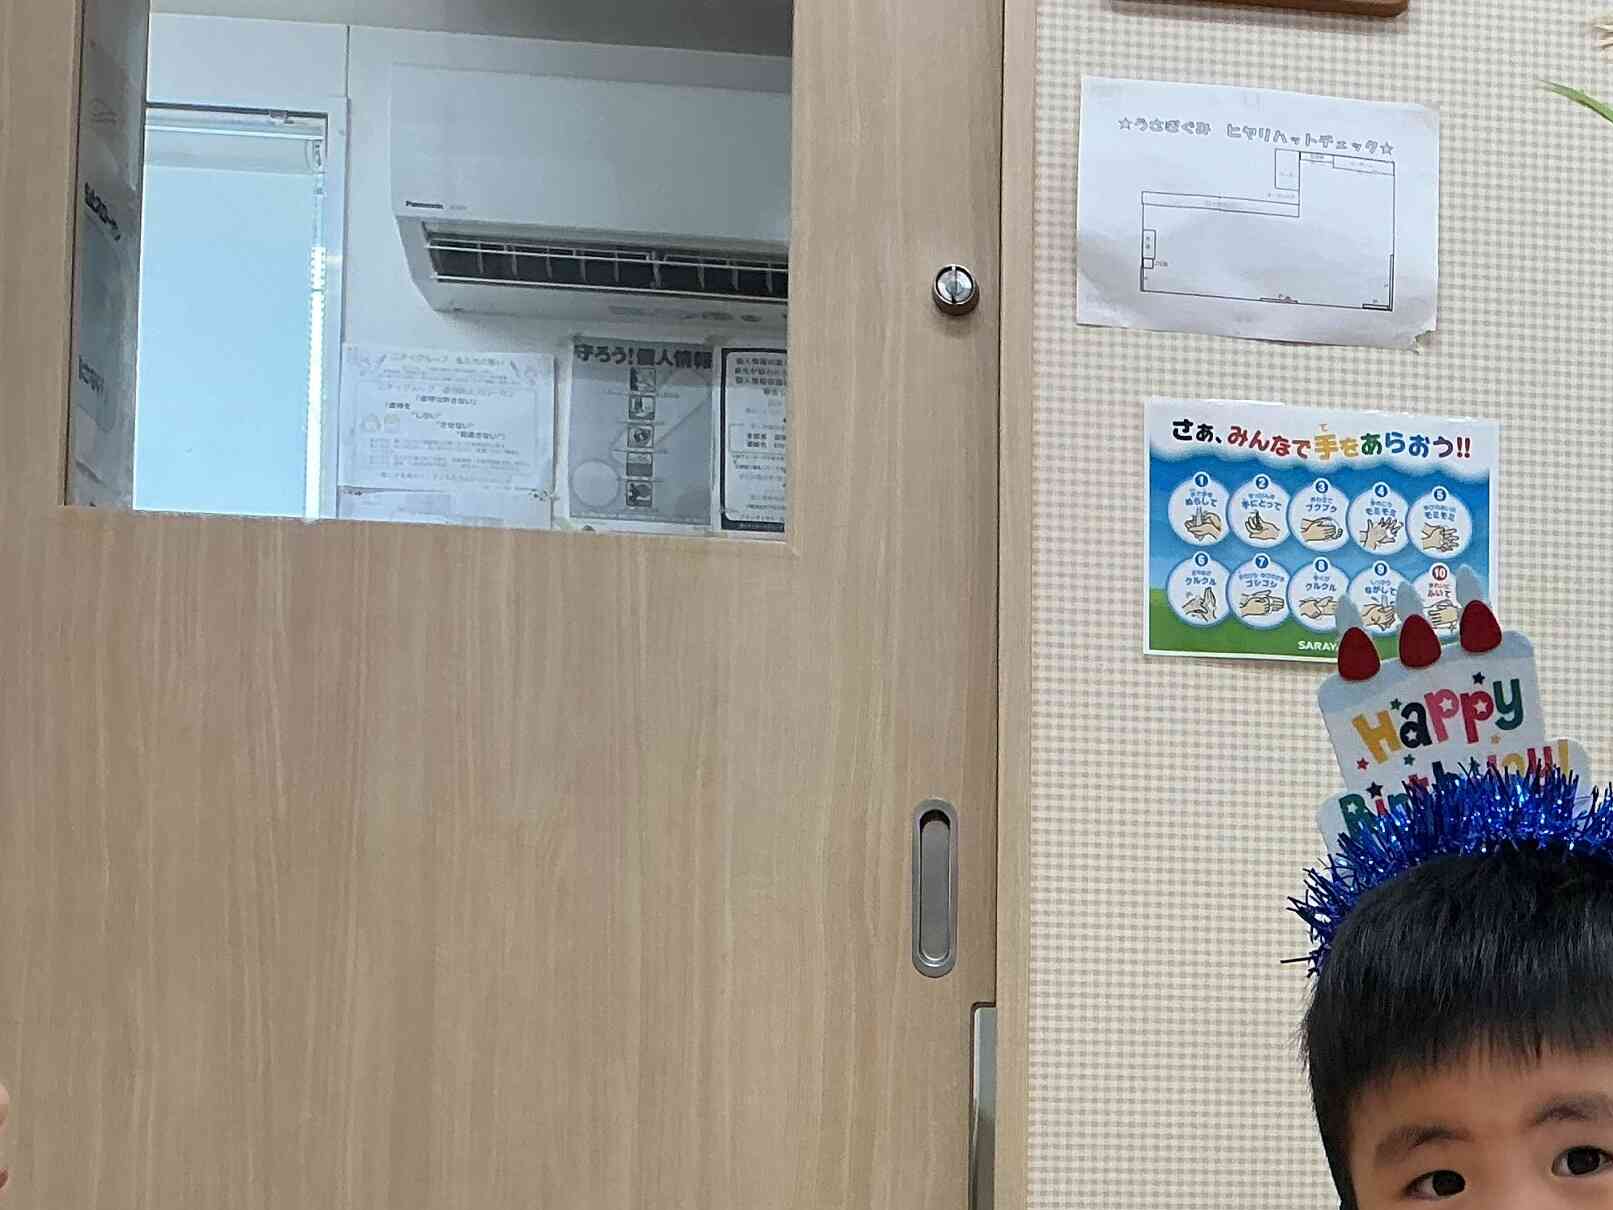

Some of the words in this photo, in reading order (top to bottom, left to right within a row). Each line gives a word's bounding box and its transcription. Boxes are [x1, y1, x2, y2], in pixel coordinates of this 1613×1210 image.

[1226, 123, 1379, 154] ヒヤリハットチェック
[1172, 418, 1472, 459] さあ、みんなで手をあらおう!!
[1241, 498, 1282, 511] 手にとって
[1365, 507, 1397, 517] モミモミ
[1425, 512, 1456, 522] モミモミ
[1297, 640, 1338, 651] SARAY
